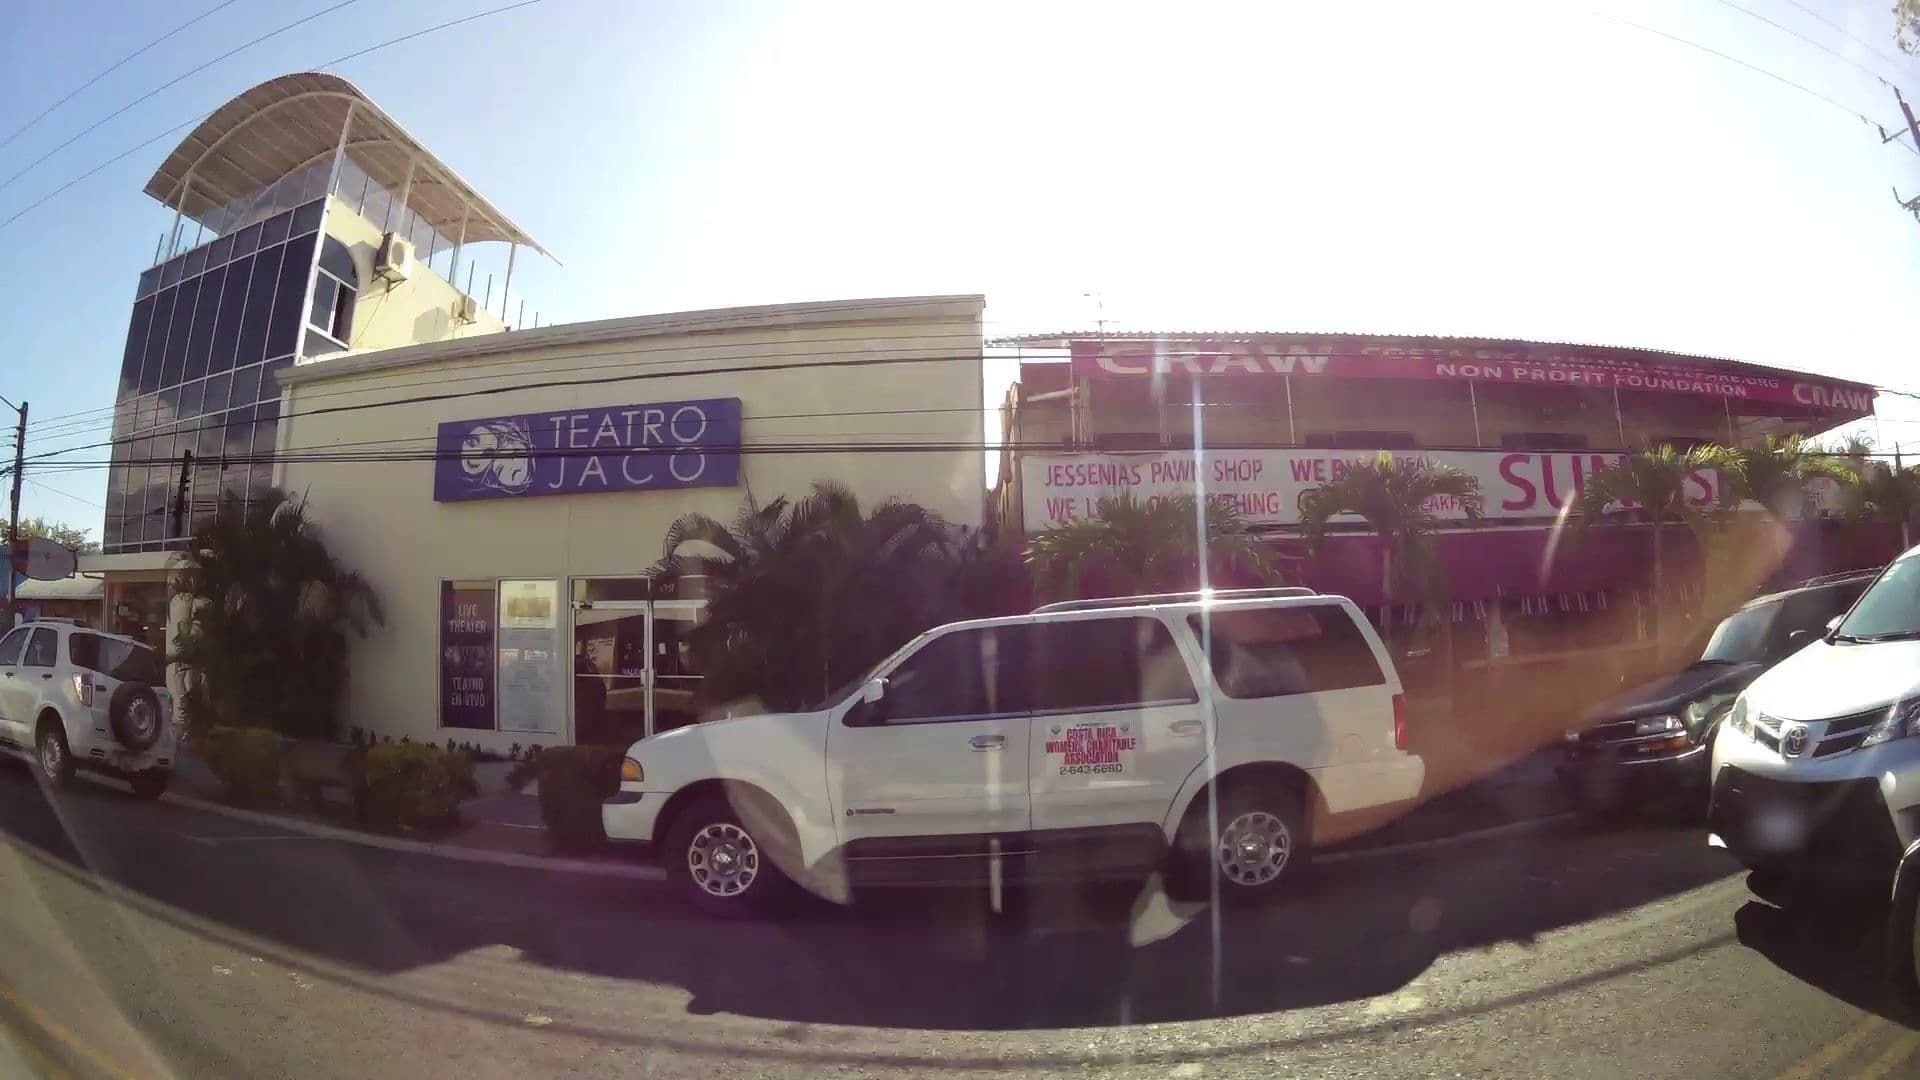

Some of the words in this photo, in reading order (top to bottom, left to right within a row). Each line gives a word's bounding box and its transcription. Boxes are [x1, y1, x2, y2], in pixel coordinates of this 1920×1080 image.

[1096, 343, 1332, 376] CRAW
[1436, 363, 1502, 380] NON
[1513, 367, 1606, 386] PROFIT
[1615, 373, 1747, 397] FOUNDATION
[1793, 382, 1870, 411] CRAW
[549, 405, 706, 450] TEATRO
[549, 447, 706, 488] JACO
[1045, 464, 1142, 487] JESSENIAS
[1213, 459, 1264, 482] SHOP
[1289, 458, 1327, 482] WE
[1047, 497, 1076, 522] WE
[458, 603, 479, 617] LIVE
[448, 619, 487, 633] THEATER
[1064, 751, 1119, 765] ASSOCIATION
